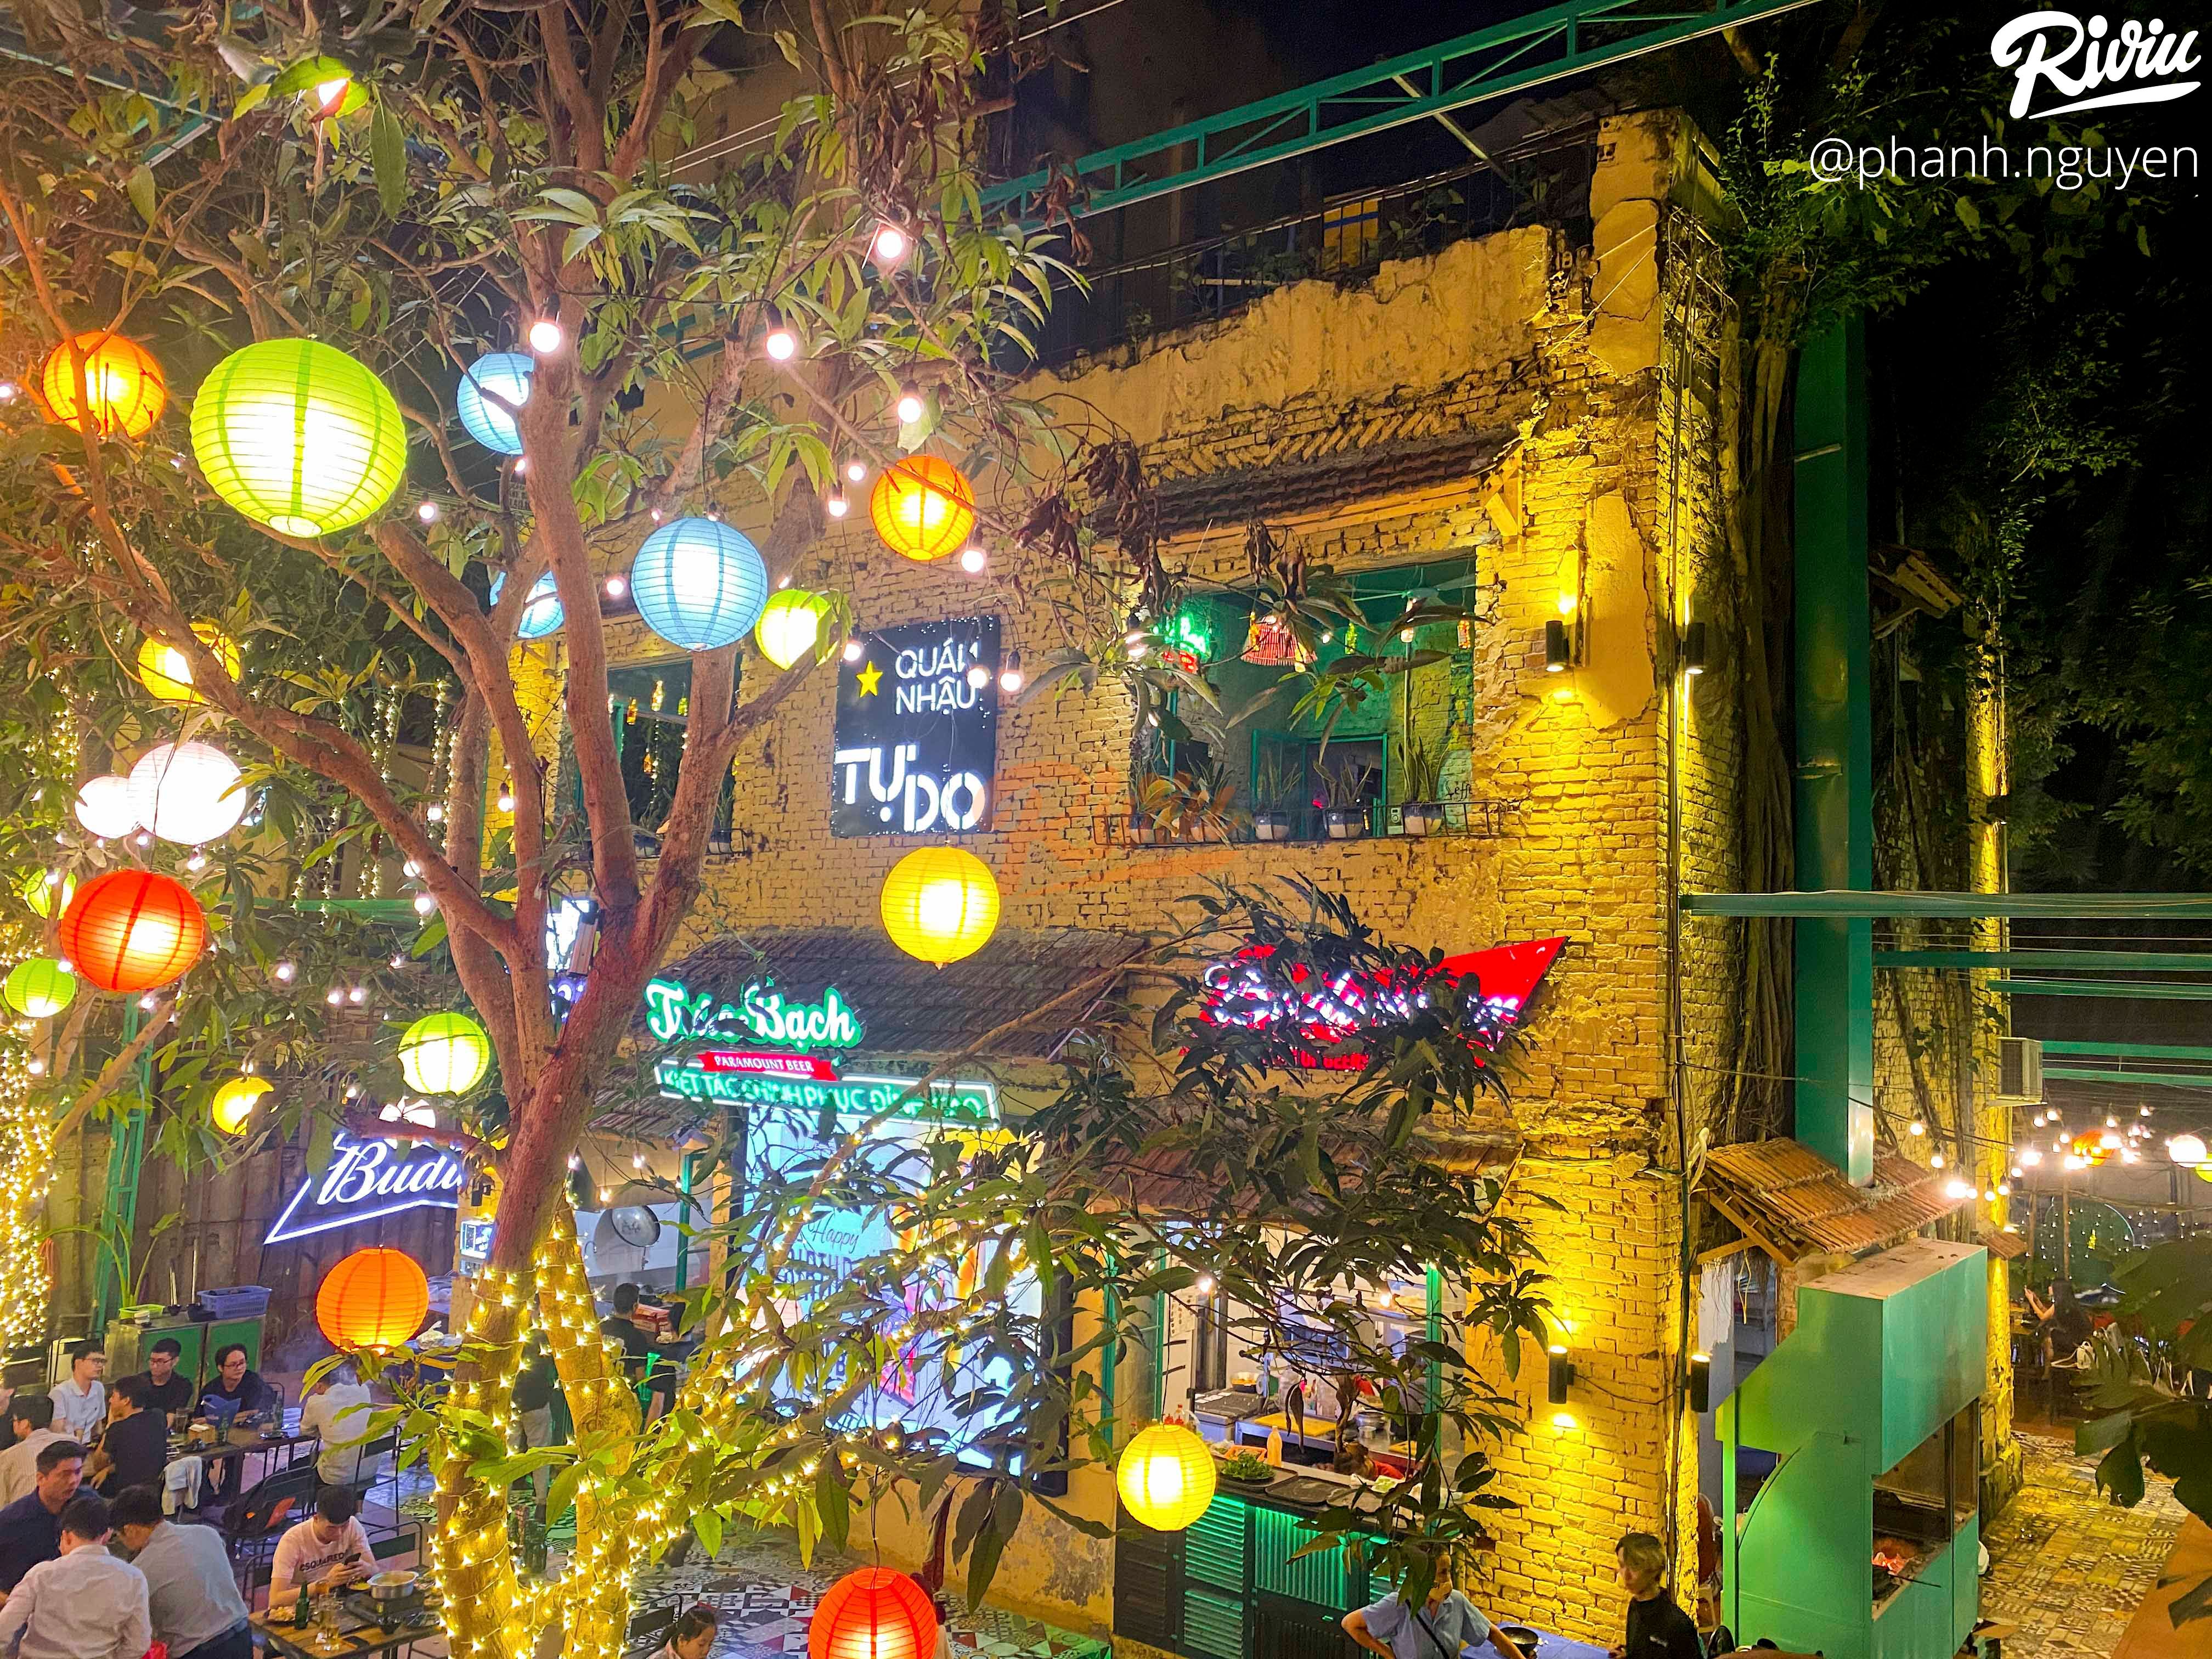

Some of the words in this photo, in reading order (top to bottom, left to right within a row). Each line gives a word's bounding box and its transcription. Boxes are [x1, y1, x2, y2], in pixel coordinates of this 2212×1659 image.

[896, 675, 976, 715] NHẬU
[903, 772, 986, 833] DO
[744, 982, 856, 1048] Bạch
[714, 1056, 785, 1071] PARAMOUNT
[785, 1059, 815, 1073] BEER
[808, 1212, 859, 1254] Happy
